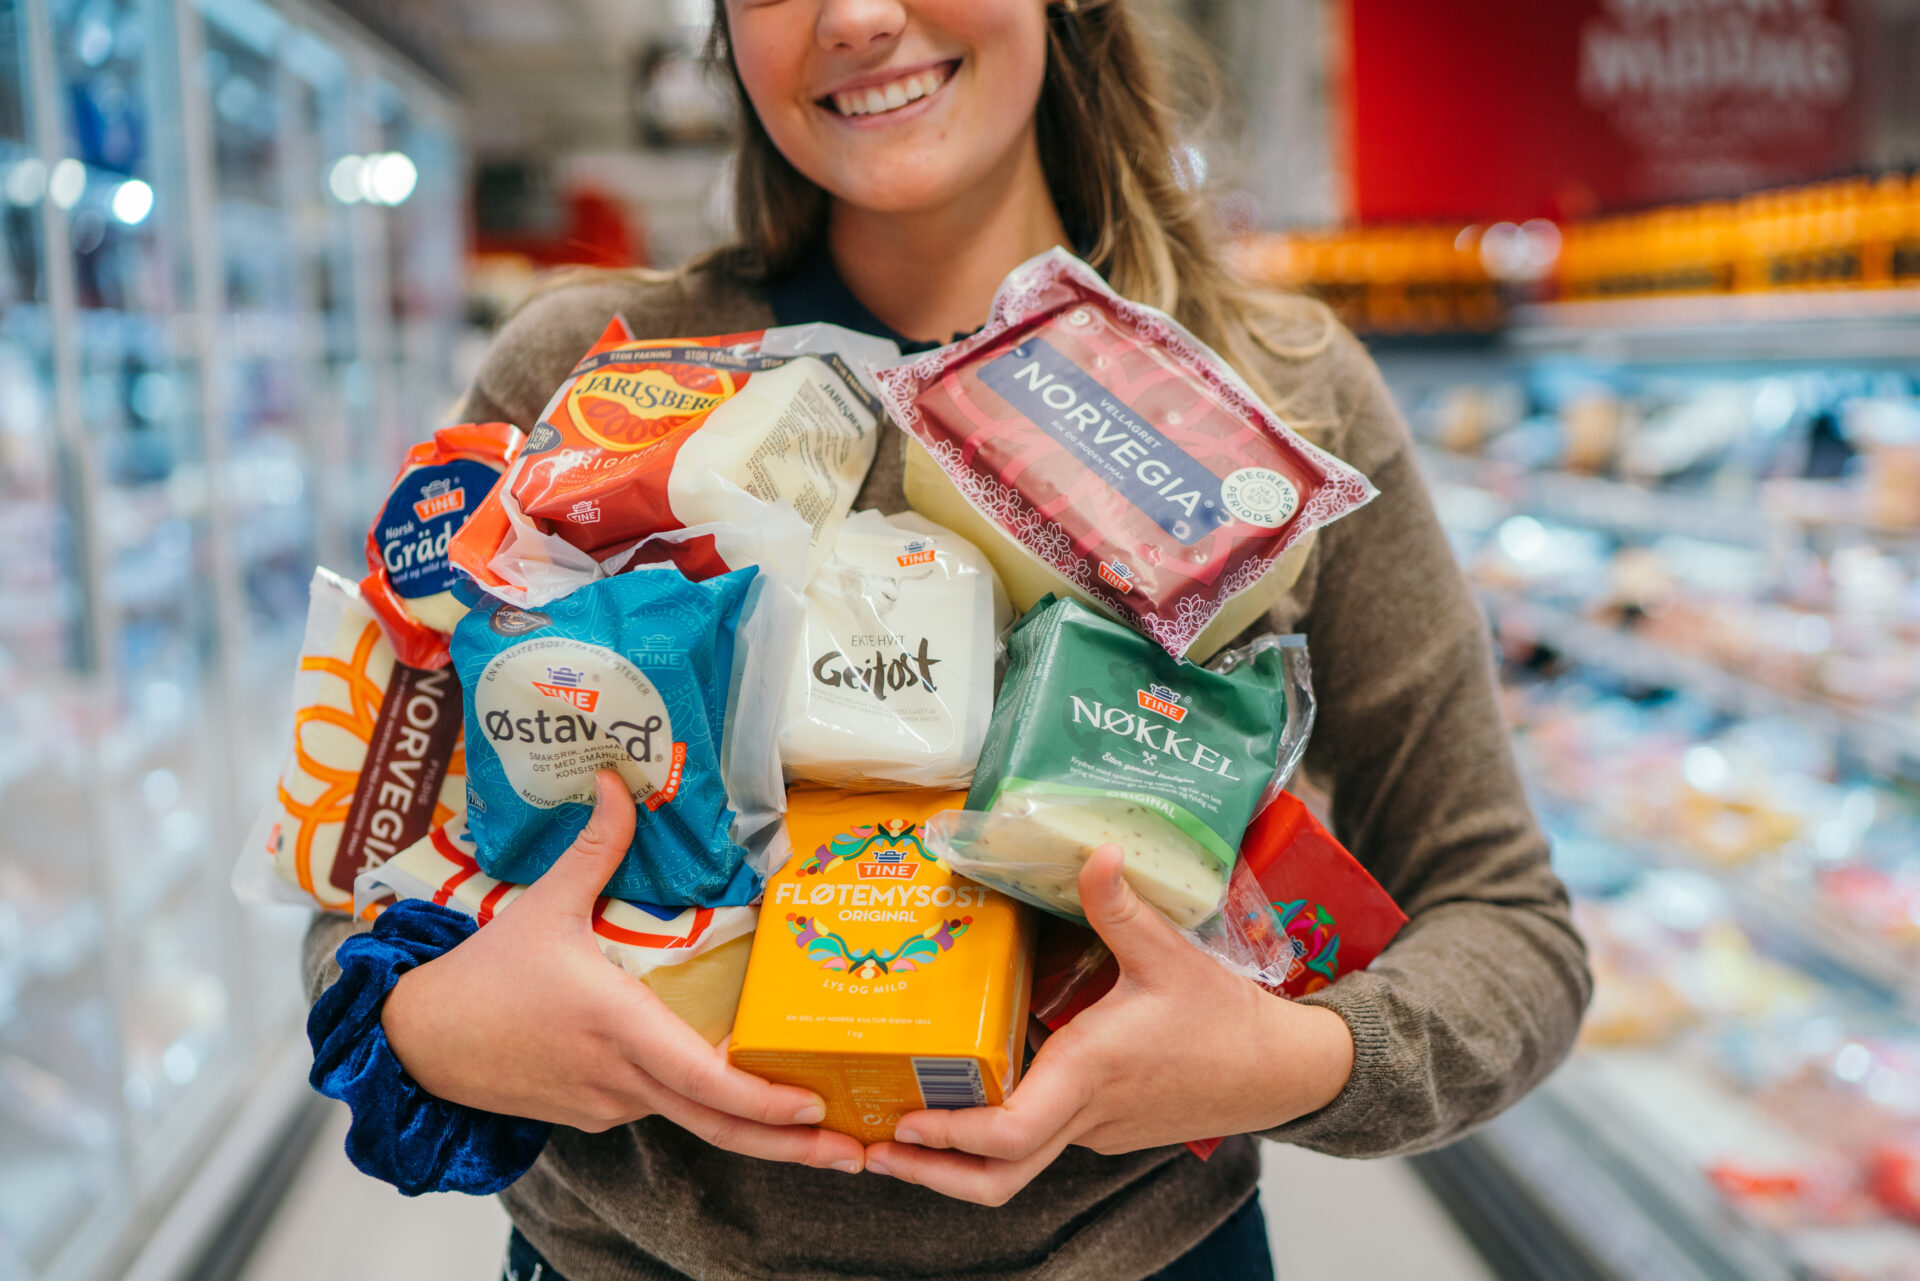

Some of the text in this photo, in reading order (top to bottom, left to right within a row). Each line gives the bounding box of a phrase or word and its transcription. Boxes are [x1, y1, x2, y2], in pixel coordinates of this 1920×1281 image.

[609, 350, 672, 362] STOR PAKNING
[685, 350, 708, 361] STOR
[576, 376, 725, 410] JARLSBERG
[1099, 398, 1162, 449] VELLAGRET
[1013, 361, 1202, 518] NORVEGIA
[420, 494, 459, 515] TINE
[1226, 485, 1273, 523] PERIODE
[1236, 471, 1294, 520] BEGRENSET
[572, 512, 596, 523] TINE
[385, 520, 415, 541] Norsk
[383, 518, 468, 574] Gräd
[421, 562, 440, 575] mild
[900, 551, 933, 566] TINE
[1102, 567, 1128, 591] TINE
[851, 634, 906, 648] EKTE HVIT
[635, 653, 681, 666] TINE
[812, 636, 943, 701] Geitost
[485, 666, 499, 682] EN
[541, 687, 592, 709] TINE
[1143, 695, 1180, 719] TINE
[1069, 695, 1241, 782] NØKKEL
[356, 669, 451, 875] NORVEGIA
[532, 762, 551, 773] OST
[554, 757, 577, 770] MED
[555, 760, 618, 780] KONSISTEN
[1095, 767, 1112, 777] med
[567, 793, 584, 803] ST
[1105, 790, 1176, 820] ORIGINAL
[863, 864, 910, 877] TINE
[775, 882, 993, 909] FLØTEMYSOST
[838, 909, 918, 923] ORIGINAL
[823, 978, 908, 995] LYS OG MILD
[827, 1015, 855, 1023] NORSK
[856, 1016, 887, 1024] KULTUR
[888, 1017, 913, 1025] SIDEN
